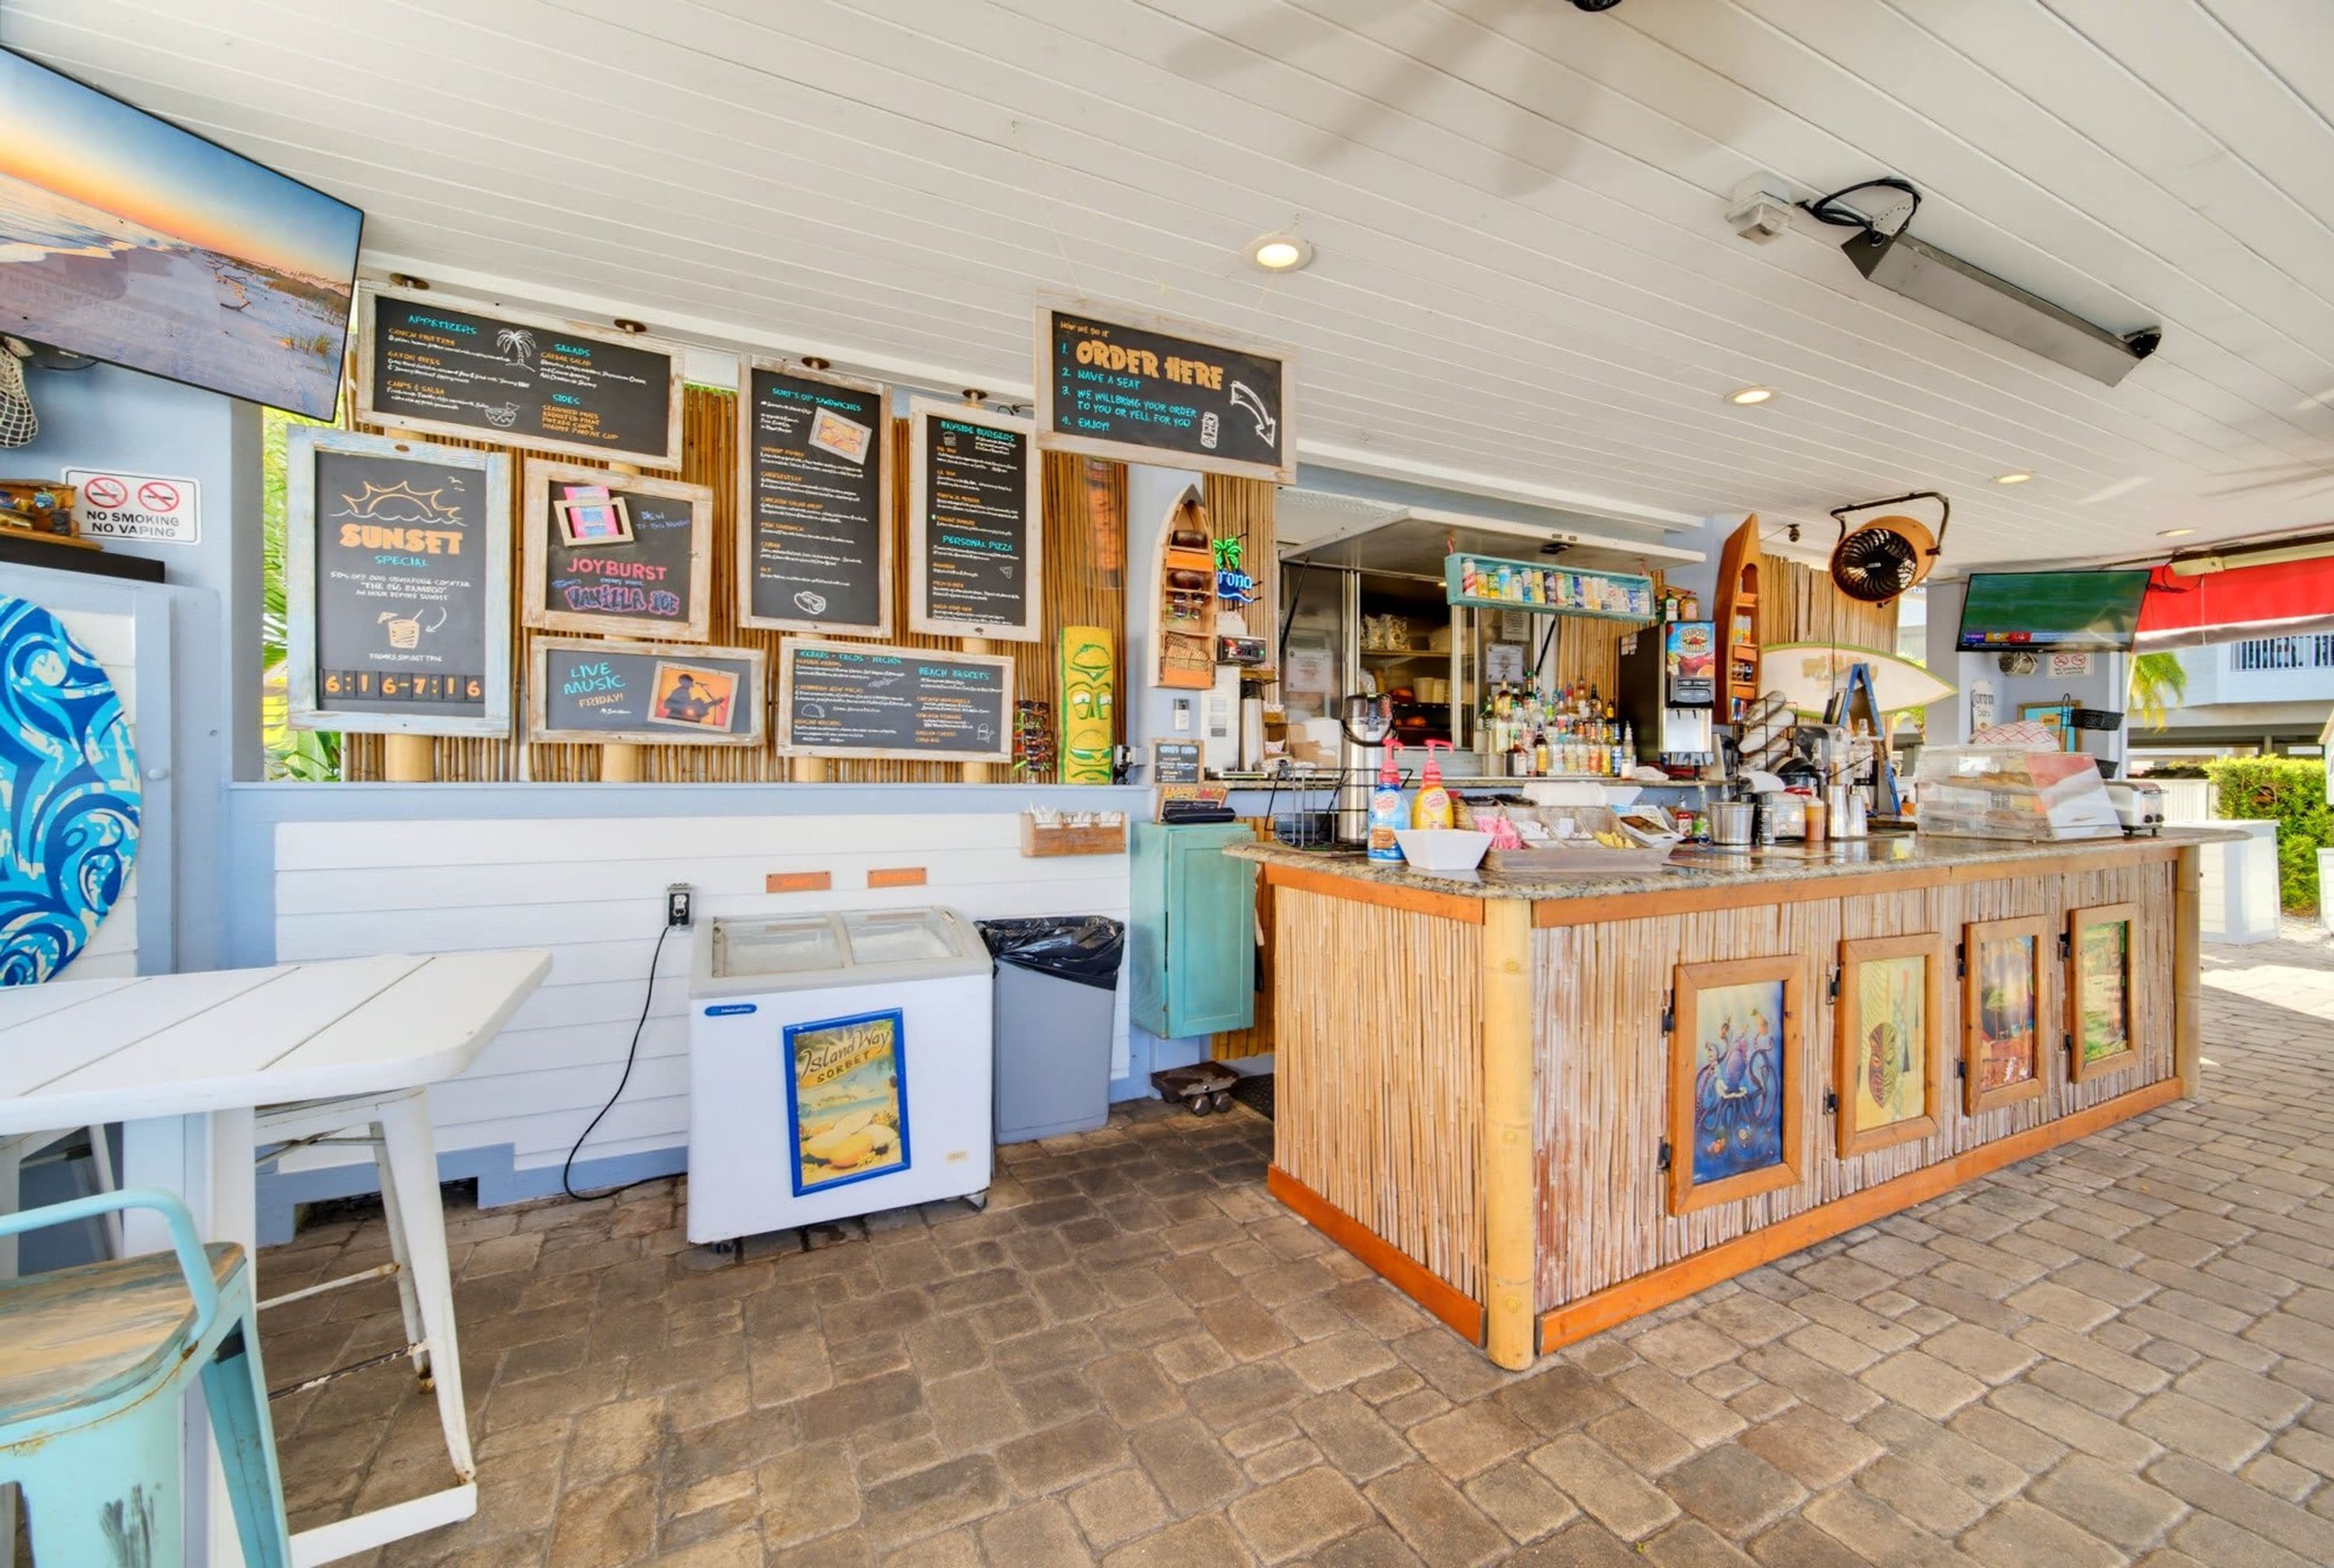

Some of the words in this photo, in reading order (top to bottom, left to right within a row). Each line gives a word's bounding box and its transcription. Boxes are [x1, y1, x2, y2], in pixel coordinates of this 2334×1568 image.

[407, 315, 478, 335] APPETIZERS
[1060, 320, 1076, 331] HOW
[1078, 324, 1090, 333] WE
[1090, 327, 1100, 336] DO
[1101, 329, 1110, 338] IT
[553, 343, 591, 357] SALADS
[1075, 339, 1160, 379] ORDER
[1164, 355, 1225, 391] HERE
[387, 380, 411, 389] CHIPS
[421, 386, 444, 395] SALSA
[1077, 369, 1105, 383] HAVE
[1107, 374, 1114, 384] A
[1116, 376, 1141, 390] SEAT
[552, 394, 581, 405] SIDES
[815, 397, 863, 412] SANDWICHES
[1077, 389, 1092, 401] WE
[1144, 401, 1167, 413] YOUR
[1169, 404, 1198, 419] ORDER
[1077, 400, 1091, 411] TO
[1093, 403, 1112, 415] YOU
[1115, 407, 1127, 418] OR
[1129, 408, 1151, 422] YELL
[1153, 414, 1171, 426] FOR
[1173, 417, 1192, 429] YOU
[1078, 418, 1110, 432] ENJOY!
[976, 427, 1015, 442] BURGERS
[86, 510, 107, 521] NO
[111, 512, 180, 527] SMOKING
[92, 523, 114, 534] NO
[119, 523, 176, 537] VAPING
[339, 523, 463, 555] SUNSET
[942, 535, 987, 548] PERSONAL
[988, 541, 1013, 551] PIZZA
[374, 555, 429, 568] SPECIAL
[567, 558, 668, 581] JOYBURST
[1218, 571, 1253, 590] rona
[565, 584, 647, 612] VANILLA
[570, 662, 612, 678] LIVE
[918, 667, 948, 677] BEACH
[951, 670, 991, 681] BASKETS
[563, 674, 627, 695] MUSIC
[578, 692, 624, 709] FRIDAY!
[801, 1041, 854, 1080] Island
[856, 1026, 891, 1055] Way
[816, 1050, 871, 1083] SORBET
